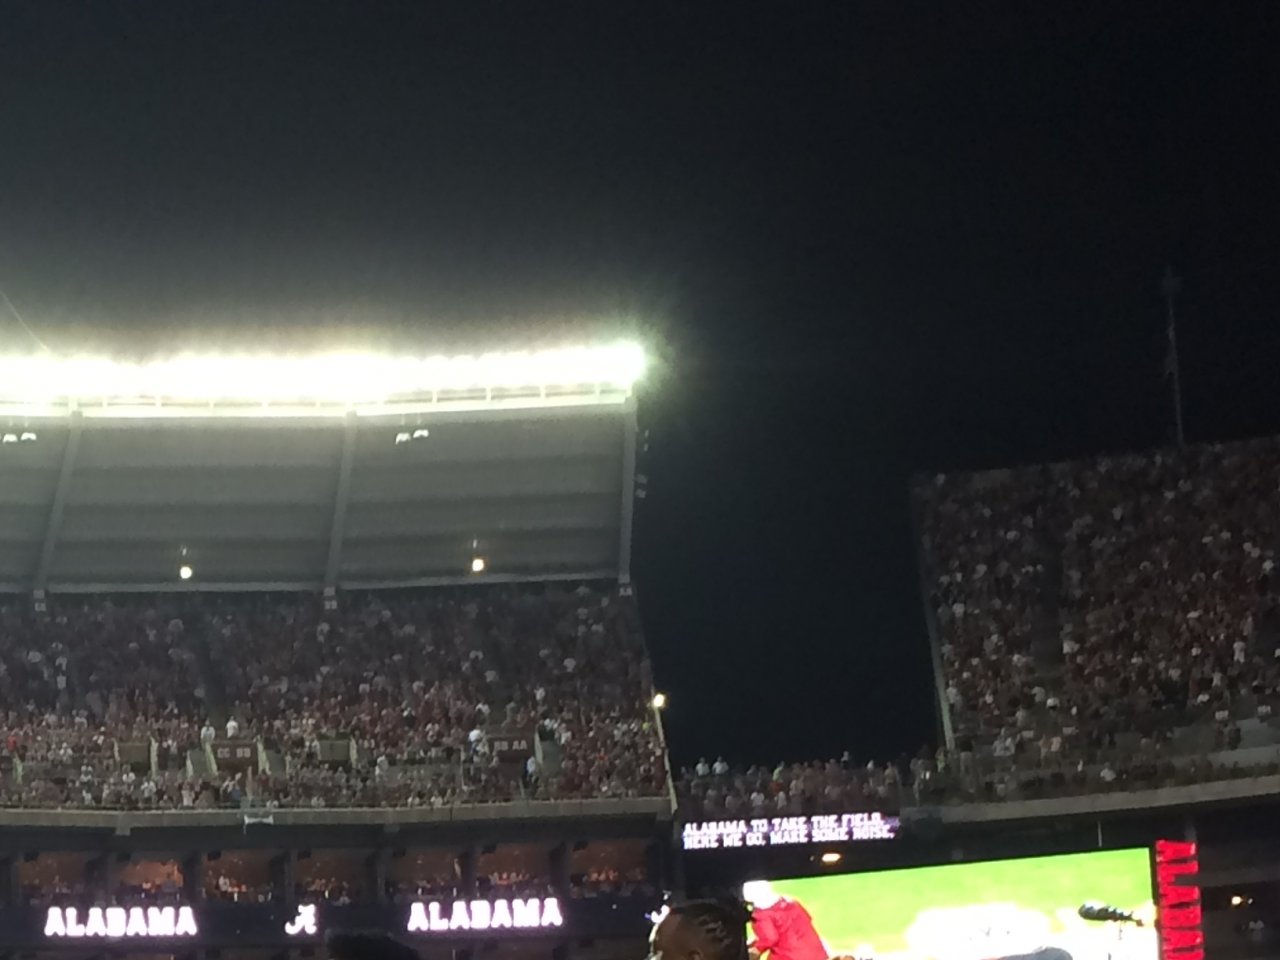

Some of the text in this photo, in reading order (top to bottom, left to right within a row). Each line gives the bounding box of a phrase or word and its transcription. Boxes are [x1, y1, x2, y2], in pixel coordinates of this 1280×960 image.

[684, 820, 747, 834] ALABAMA
[750, 819, 768, 832] TO
[772, 816, 808, 831] TAKE
[811, 814, 838, 829] THE
[683, 834, 719, 849] HERE
[722, 833, 744, 848] WE
[770, 830, 808, 845] MAKE
[811, 827, 850, 842] SOME
[44, 906, 197, 937] ALABAMA
[407, 896, 563, 932] ALABAMA
